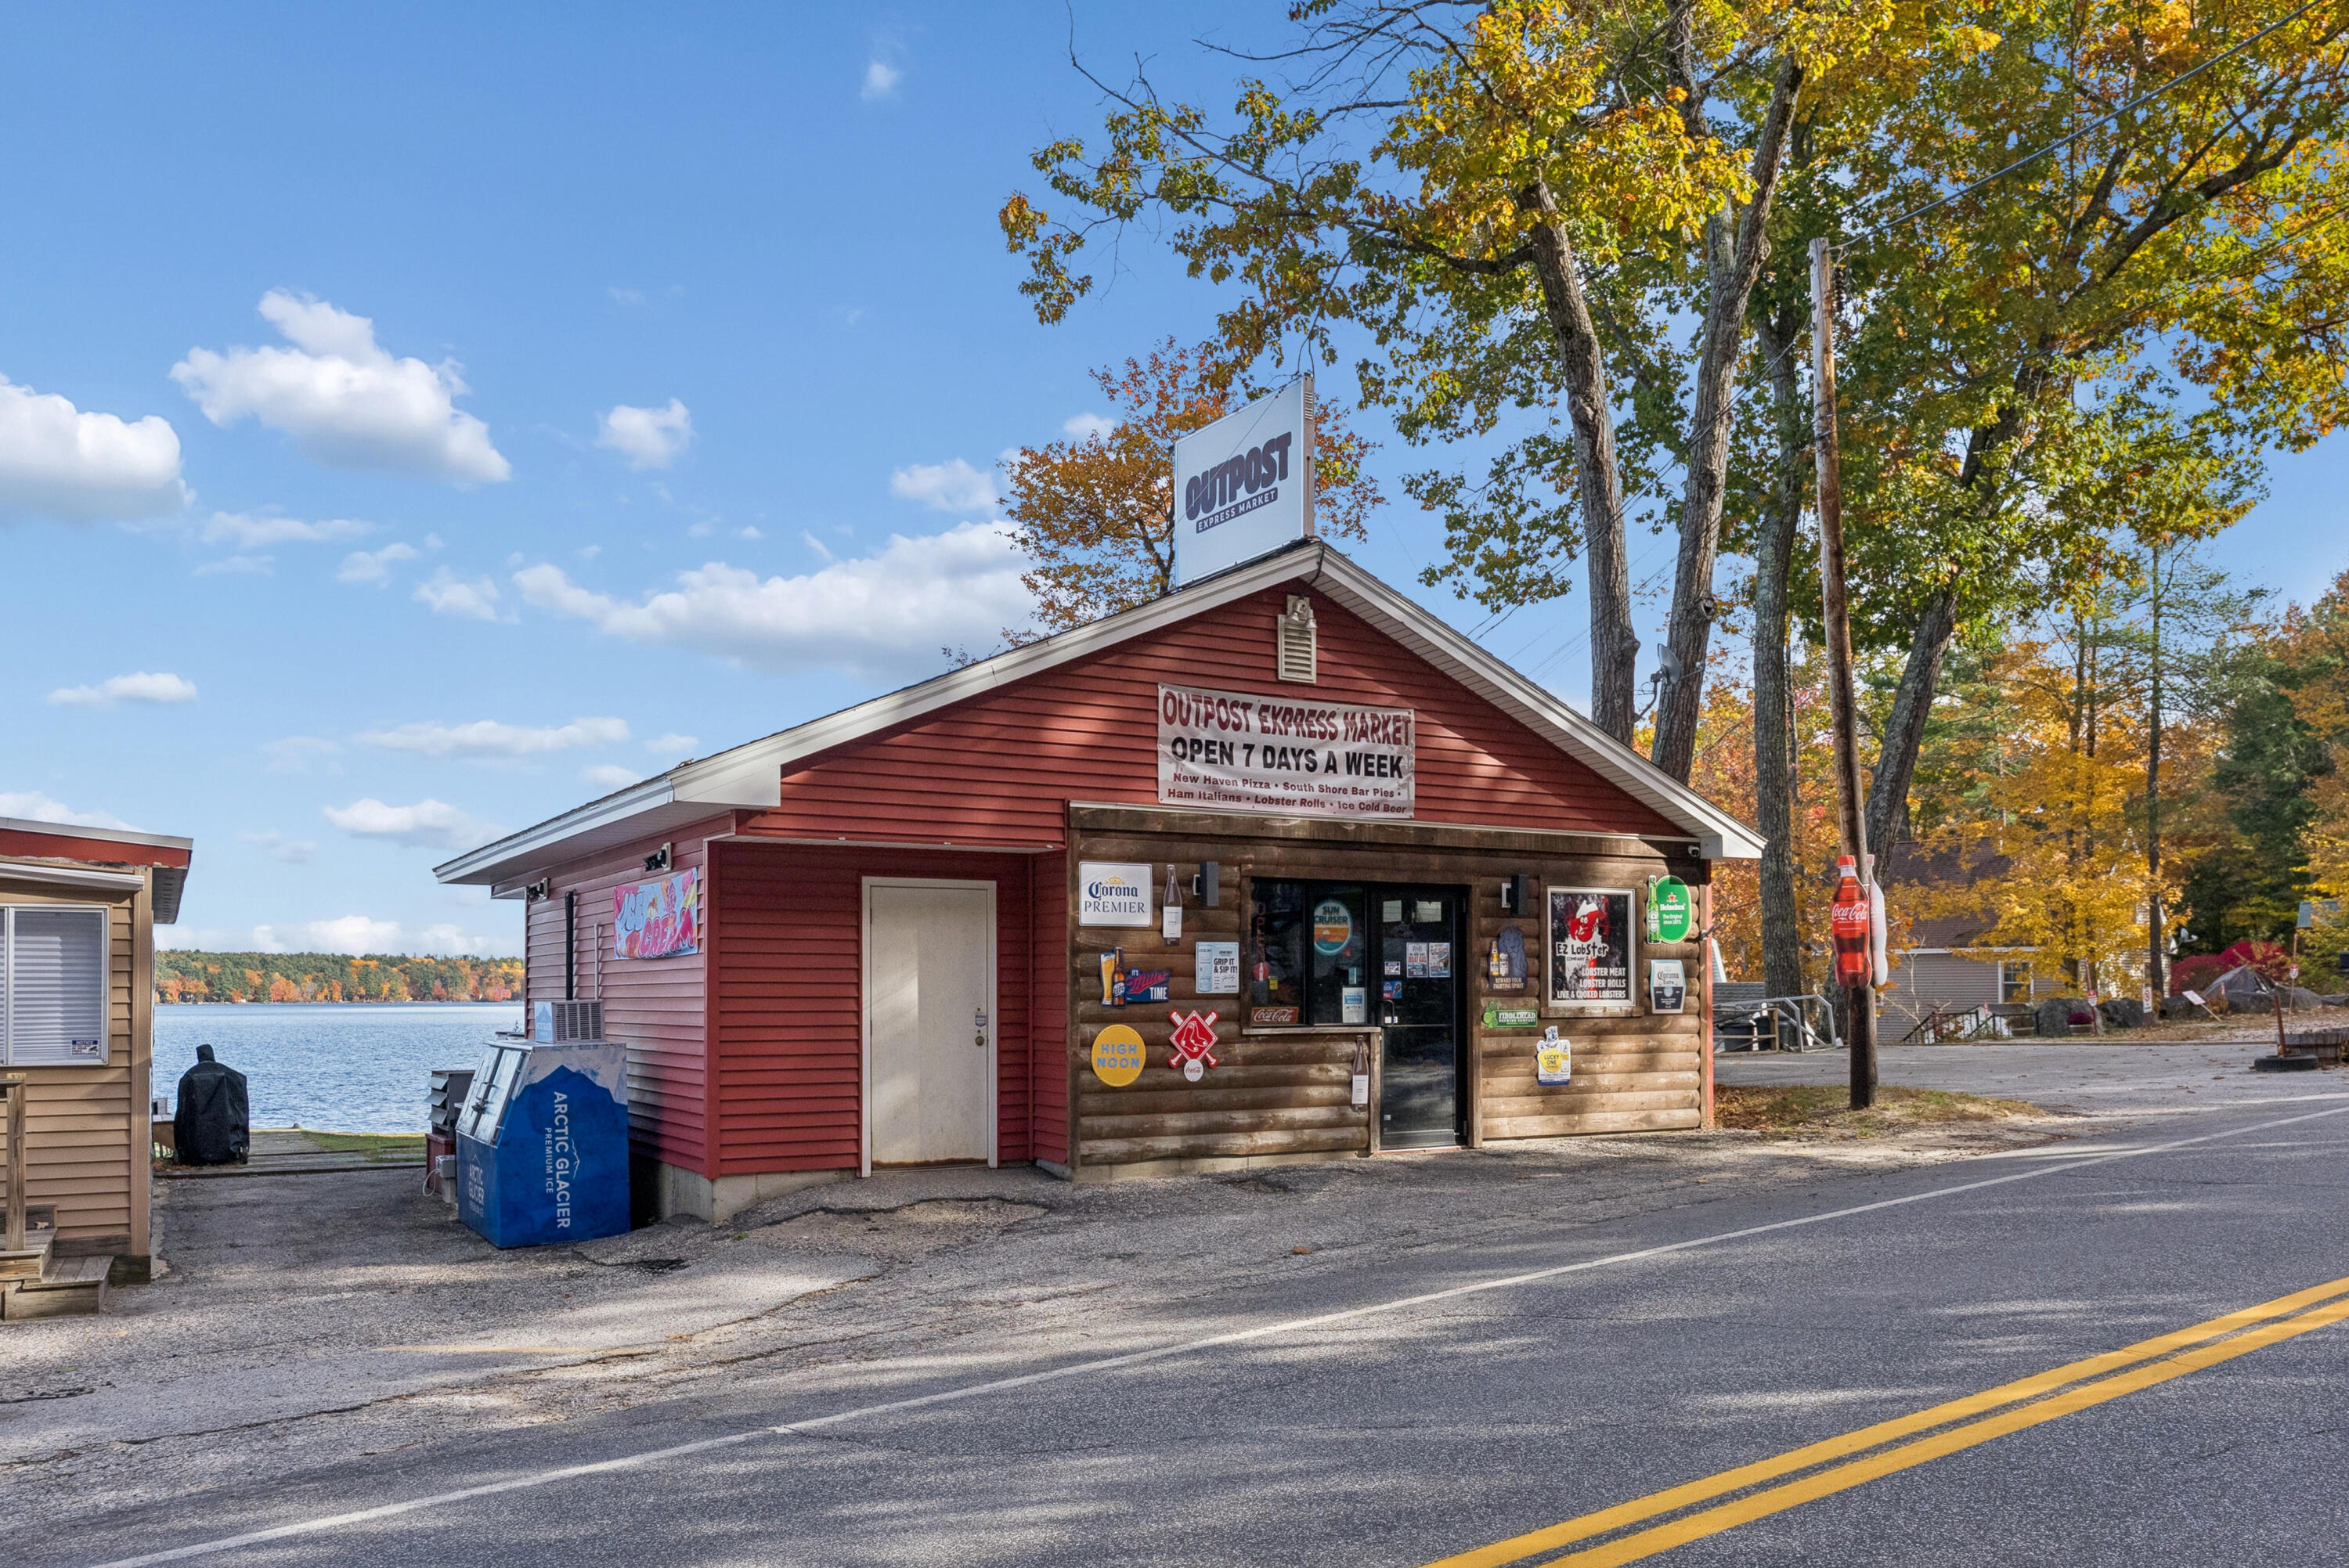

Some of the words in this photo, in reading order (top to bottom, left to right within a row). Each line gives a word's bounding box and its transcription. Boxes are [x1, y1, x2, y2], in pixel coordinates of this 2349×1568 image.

[1185, 431, 1292, 521] OUTPOST
[1198, 506, 1236, 532] EXPRESS
[1239, 490, 1276, 514] MARKET
[1162, 690, 1253, 732] OUTPOST
[1257, 704, 1339, 741] EXPRESS
[1344, 711, 1412, 746] MARKET
[1171, 736, 1235, 766] OPEN
[1243, 744, 1256, 767] 7
[1262, 744, 1319, 773] DAYS
[1324, 751, 1338, 774] A
[1345, 751, 1403, 779] WEEK
[1173, 773, 1199, 783] New
[1203, 775, 1238, 787] Haven
[1242, 778, 1271, 789] Pizza
[1283, 782, 1315, 792] South
[1318, 784, 1348, 795] Shore
[1351, 787, 1369, 796] Bar
[1373, 788, 1395, 798] Pies
[1167, 788, 1194, 799] Ham
[1198, 790, 1242, 802] Italians
[1254, 795, 1297, 806] Lobster
[1300, 798, 1326, 809] Rolls
[1338, 800, 1355, 810] Ice
[1359, 802, 1380, 812] Cold
[1383, 803, 1407, 814] Beer
[1088, 881, 1138, 900] Corona
[618, 891, 644, 932] ICE
[1084, 900, 1146, 914] PREMIER
[1832, 903, 1867, 921] Coca-Cola
[638, 907, 695, 957] CREAM
[1557, 943, 1568, 955] EZ
[1582, 968, 1608, 976] LOBSTER
[1609, 968, 1626, 976] MEAT
[1658, 971, 1680, 980] Corona
[1149, 986, 1168, 1000] TIME
[1579, 979, 1607, 988] LOBSTER
[1607, 979, 1626, 988] ROLLS
[1557, 990, 1570, 999] LIVE
[1576, 990, 1598, 999] COOKED
[1599, 990, 1626, 999] LOBSTERS
[1254, 1008, 1294, 1022] Coca-Cola
[1101, 1044, 1138, 1054] HIGH
[1097, 1057, 1140, 1068] NOON
[554, 1091, 569, 1153] ARCTIC
[544, 1127, 553, 1173] PREMIUM
[555, 1158, 571, 1228] GLACIER
